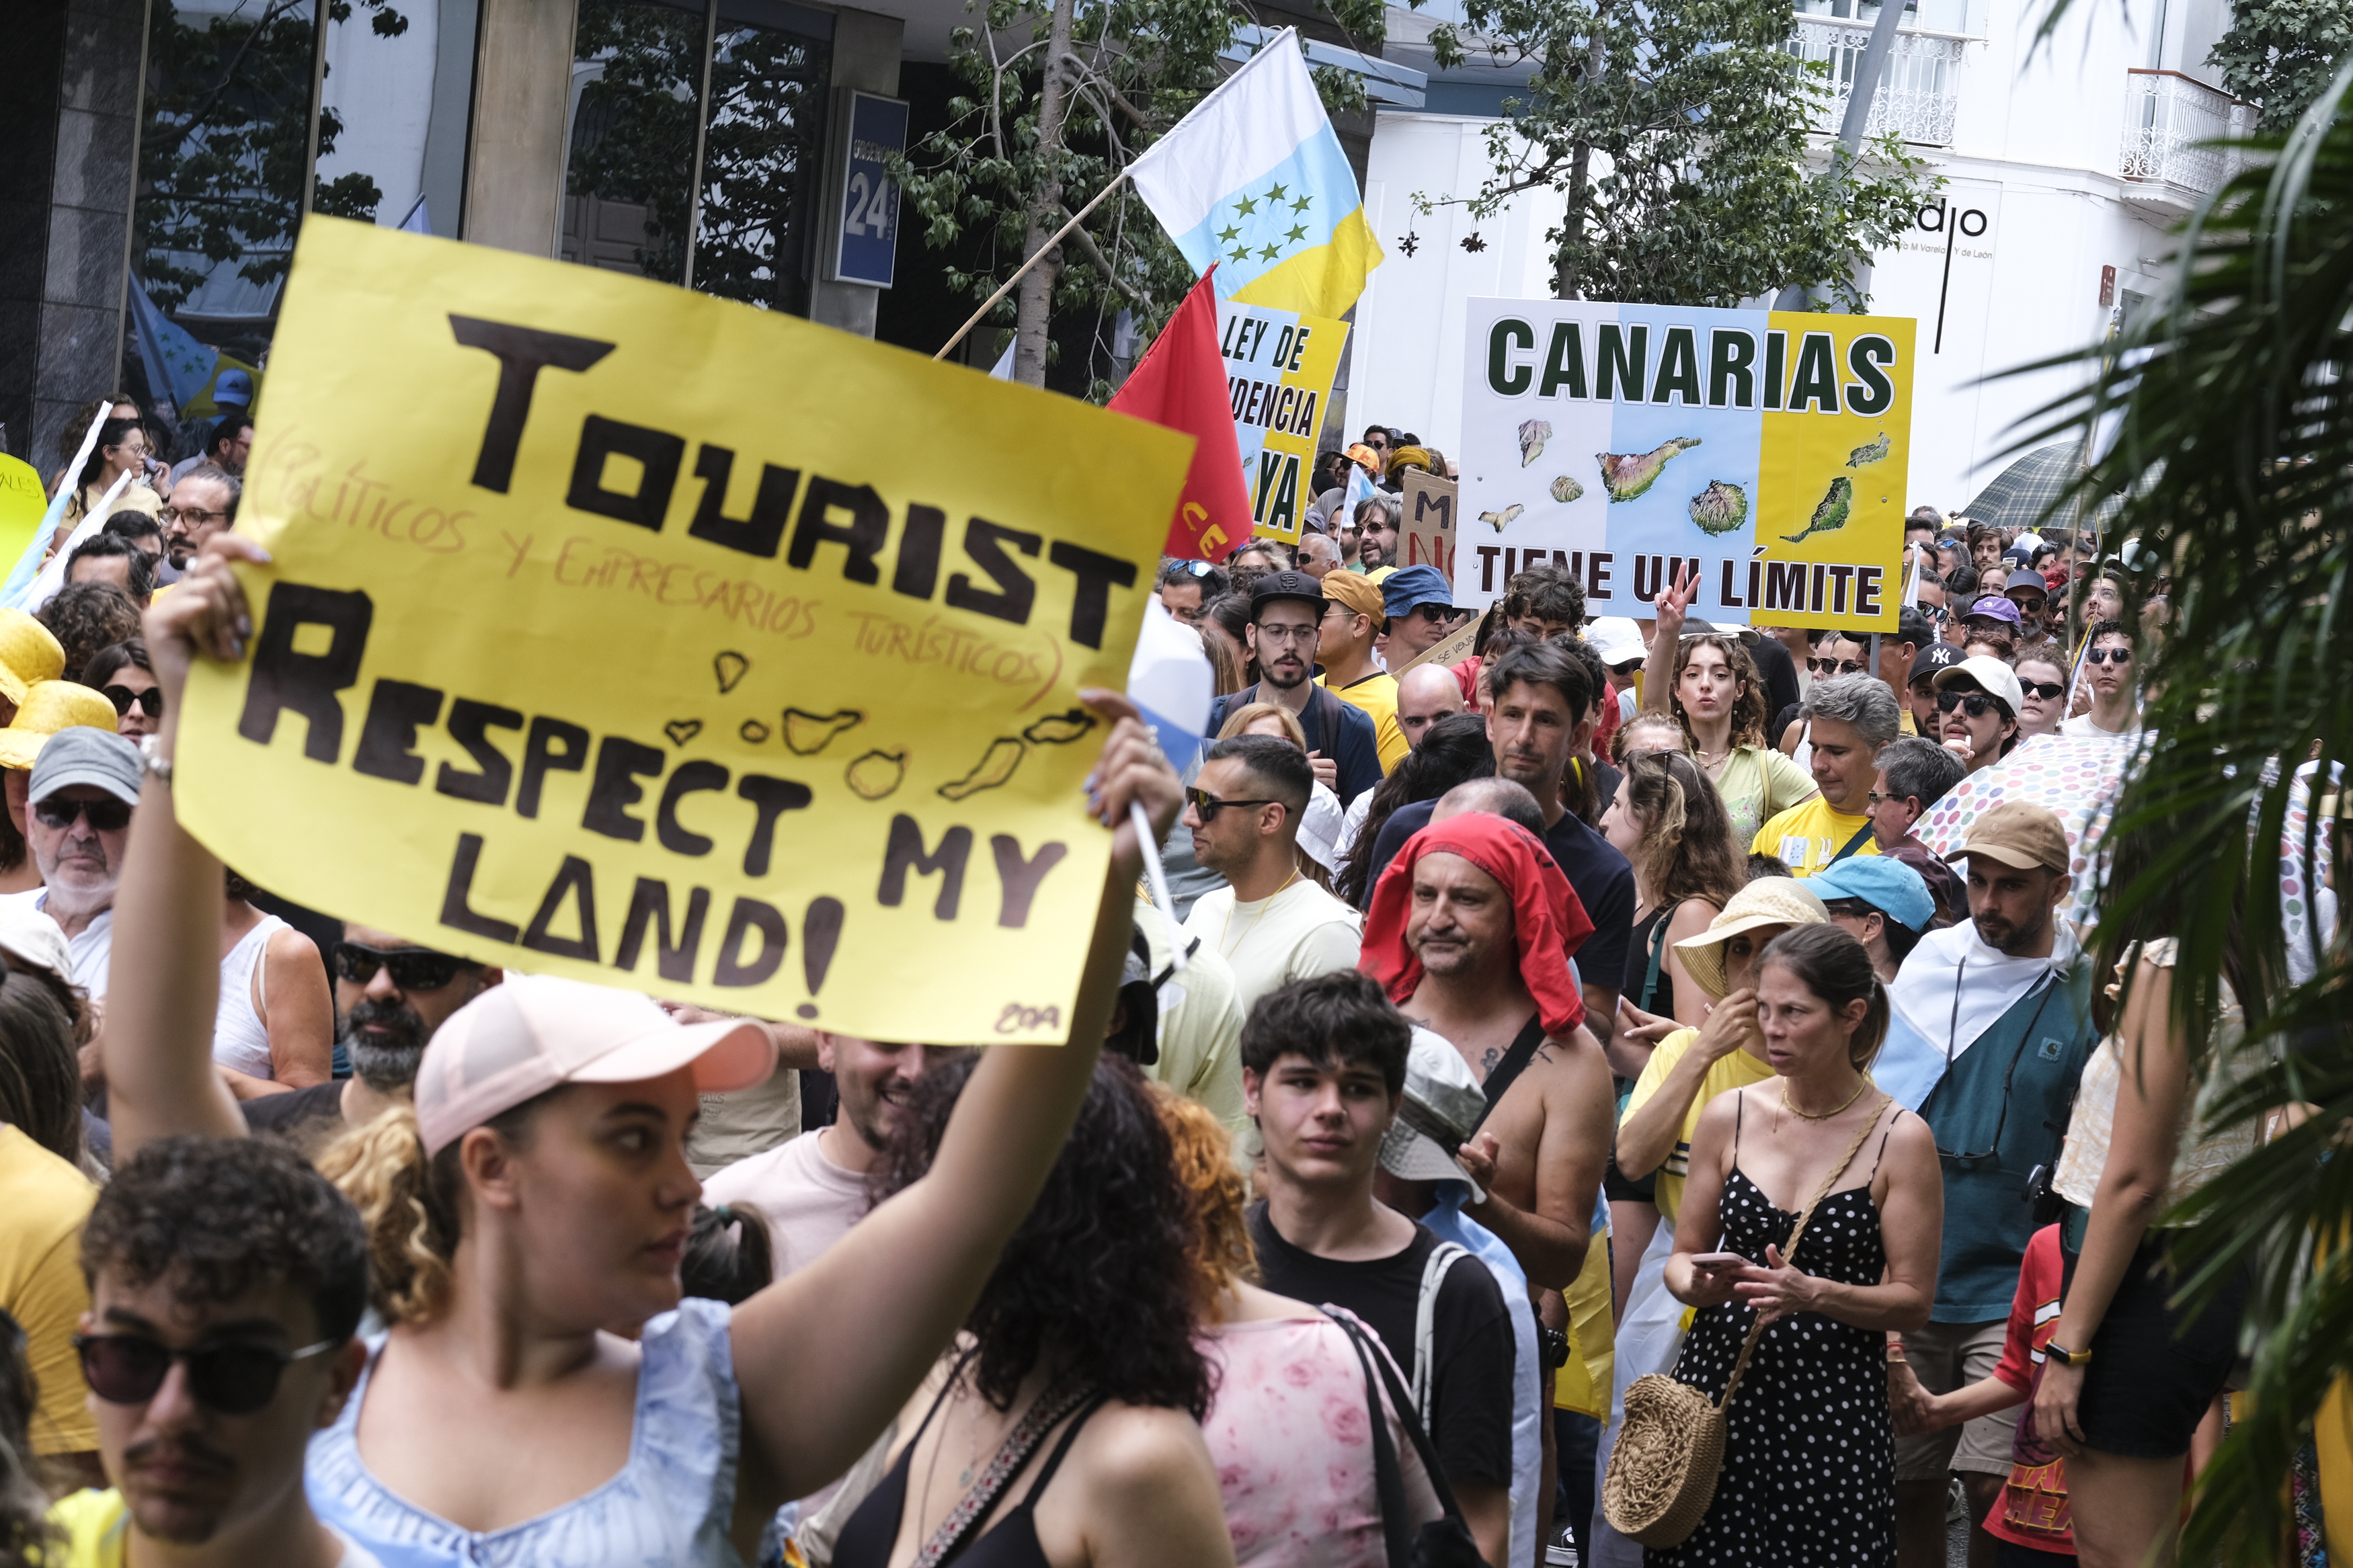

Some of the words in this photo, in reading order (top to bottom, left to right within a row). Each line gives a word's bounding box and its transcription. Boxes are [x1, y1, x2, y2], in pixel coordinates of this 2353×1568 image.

[845, 171, 889, 239] 24
[1911, 243, 1919, 251] M
[1921, 243, 1946, 254] Varela
[1954, 247, 1961, 255] Y
[1961, 248, 1972, 257] de
[1222, 315, 1269, 363] LEY
[1272, 323, 1310, 371] DE
[1487, 319, 1895, 414] CANARIAS
[448, 313, 1139, 651] TOURIST
[1253, 450, 1300, 530] YA
[1415, 491, 1458, 532] M
[500, 529, 536, 580] Y
[1409, 532, 1455, 582] N
[1634, 555, 1700, 604] UN
[1720, 546, 1882, 614] LÍMITE
[1438, 650, 1451, 663] SE
[1931, 647, 1951, 664] NY
[237, 579, 813, 878] RESPECT
[876, 812, 1069, 929] MY
[438, 833, 846, 1020] LAND!
